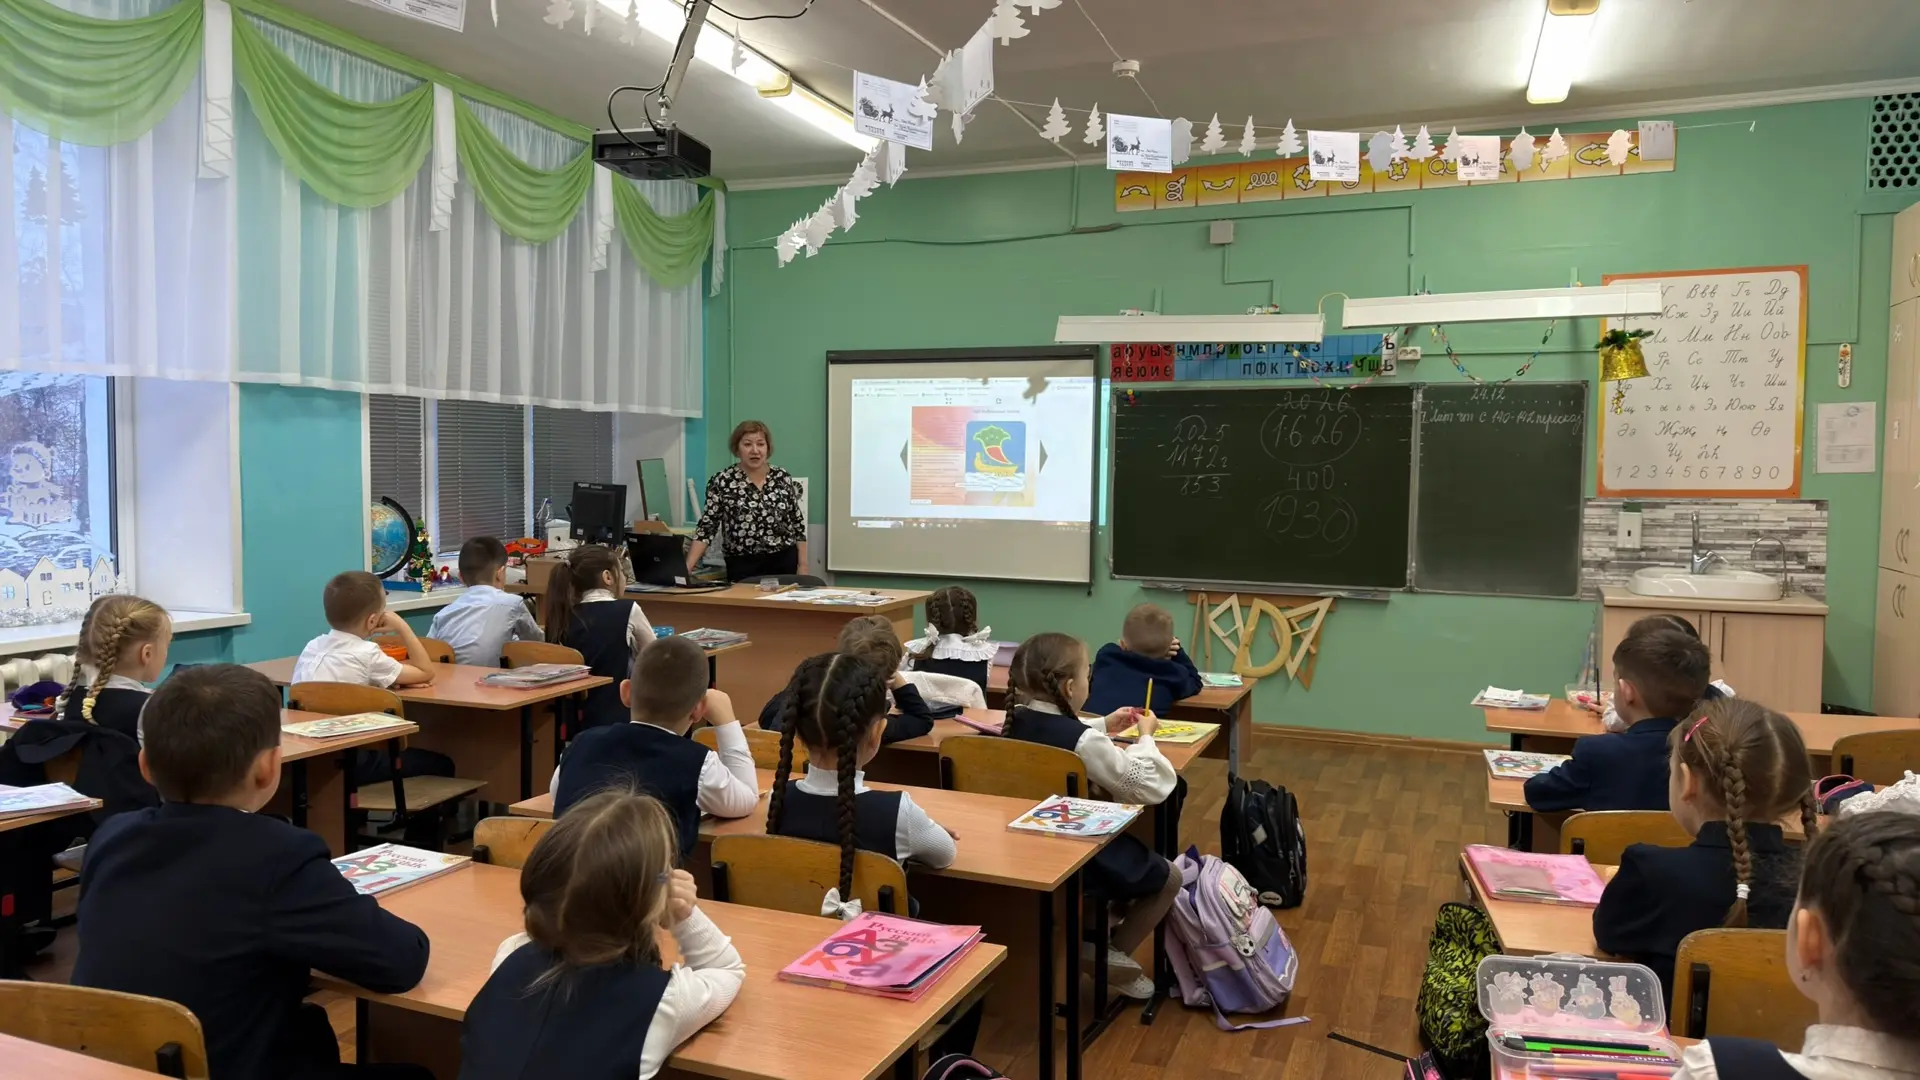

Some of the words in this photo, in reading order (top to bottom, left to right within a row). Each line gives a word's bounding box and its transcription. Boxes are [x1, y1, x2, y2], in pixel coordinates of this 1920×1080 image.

[1470, 387, 1506, 400] 24.12
[1616, 466, 1622, 479] 1
[1630, 466, 1640, 479] 2
[1647, 466, 1658, 479] 3
[1665, 466, 1674, 479] 4
[1682, 466, 1692, 479] 5
[1700, 466, 1709, 479] 6
[1718, 466, 1726, 479] 7
[1734, 466, 1744, 479] 8
[1752, 466, 1762, 479] 9
[1768, 466, 1780, 479] 0
[1263, 495, 1350, 542] 1930
[868, 921, 934, 938] Русский
[888, 932, 940, 946] язык
